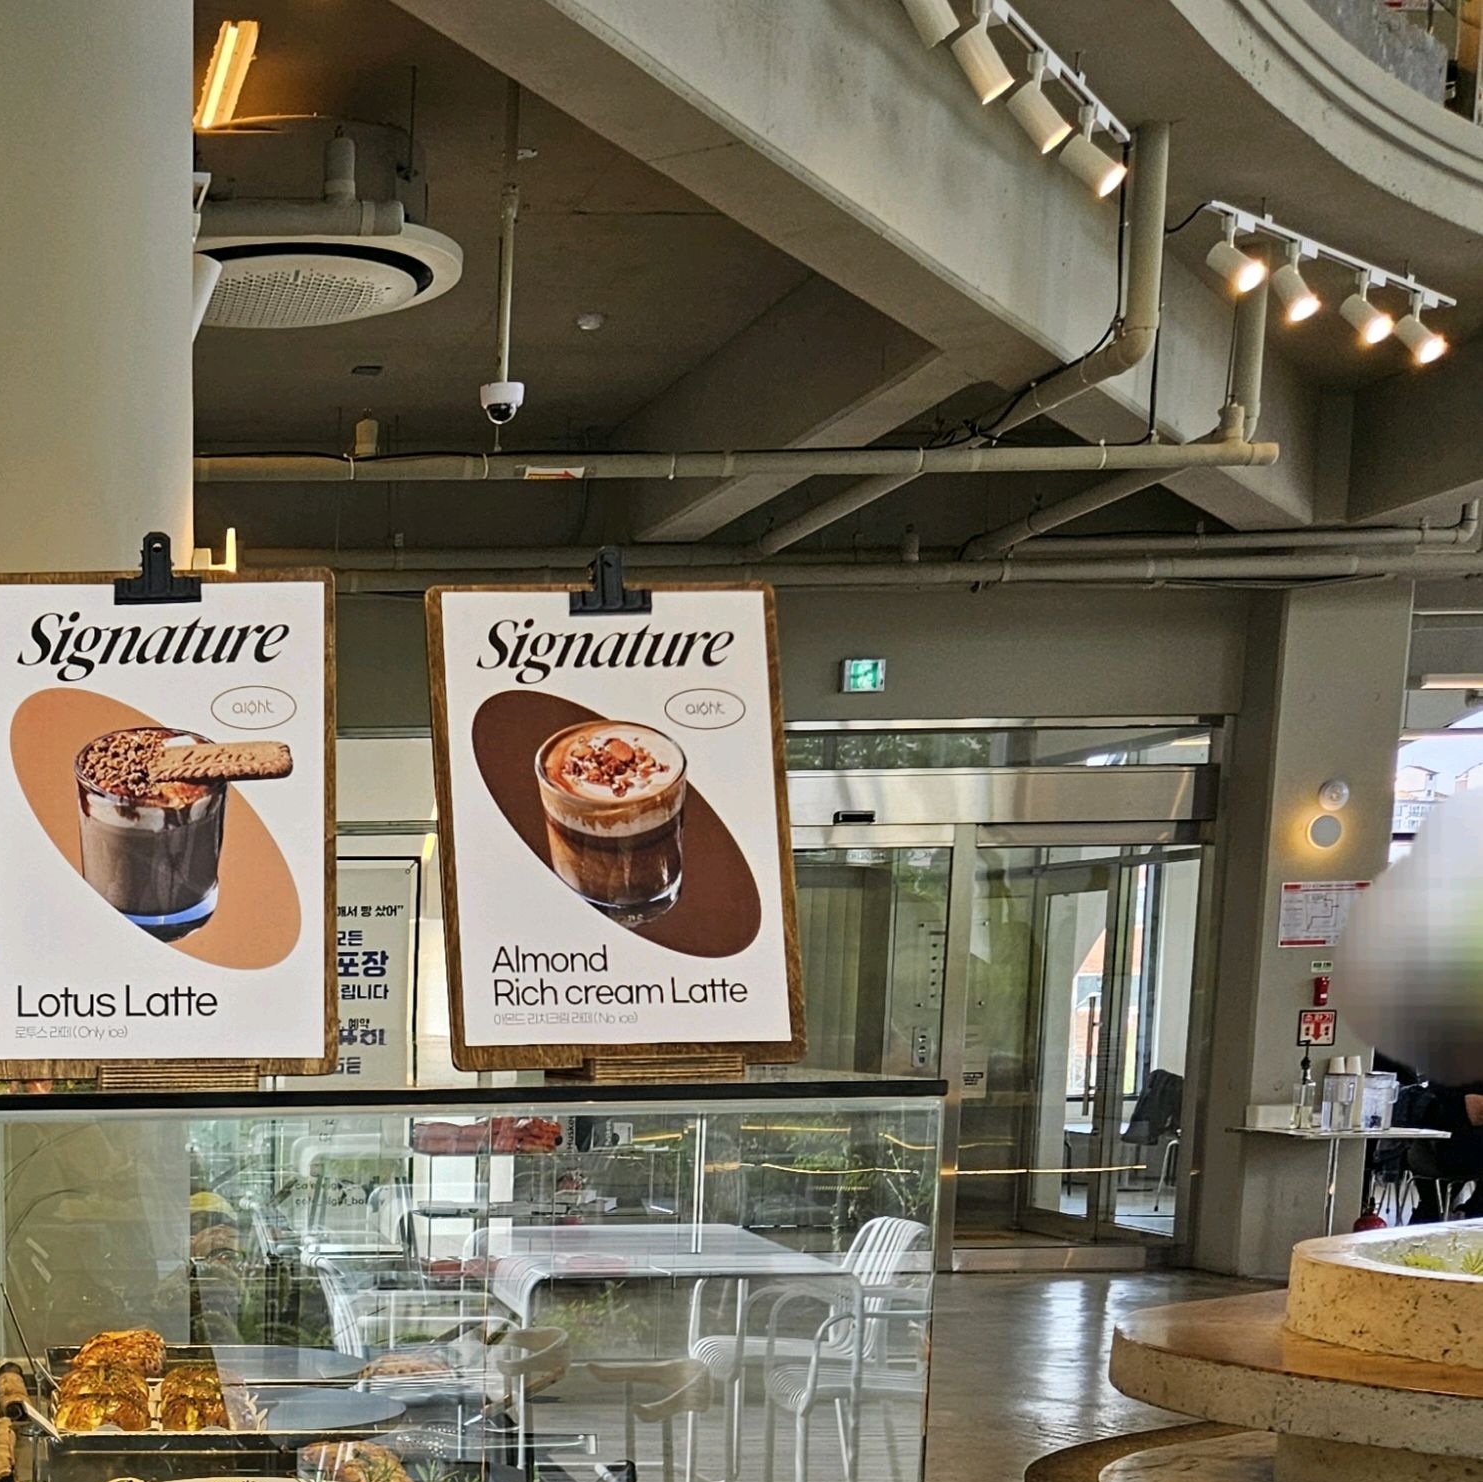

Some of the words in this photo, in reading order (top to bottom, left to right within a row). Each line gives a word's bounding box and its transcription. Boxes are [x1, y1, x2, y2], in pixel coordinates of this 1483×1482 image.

[16, 611, 289, 682] Signature
[476, 618, 735, 684] Signature
[337, 950, 389, 977] 포장
[492, 944, 608, 973] Almond
[16, 985, 116, 1018] Lotus
[125, 984, 218, 1018] Latte
[494, 977, 558, 1007] Rich
[565, 983, 665, 1006] cream
[670, 976, 748, 1004] Latte
[15, 1026, 47, 1038] 로투스
[493, 1013, 525, 1025] 아몬드
[528, 1013, 569, 1024] 리치크림
